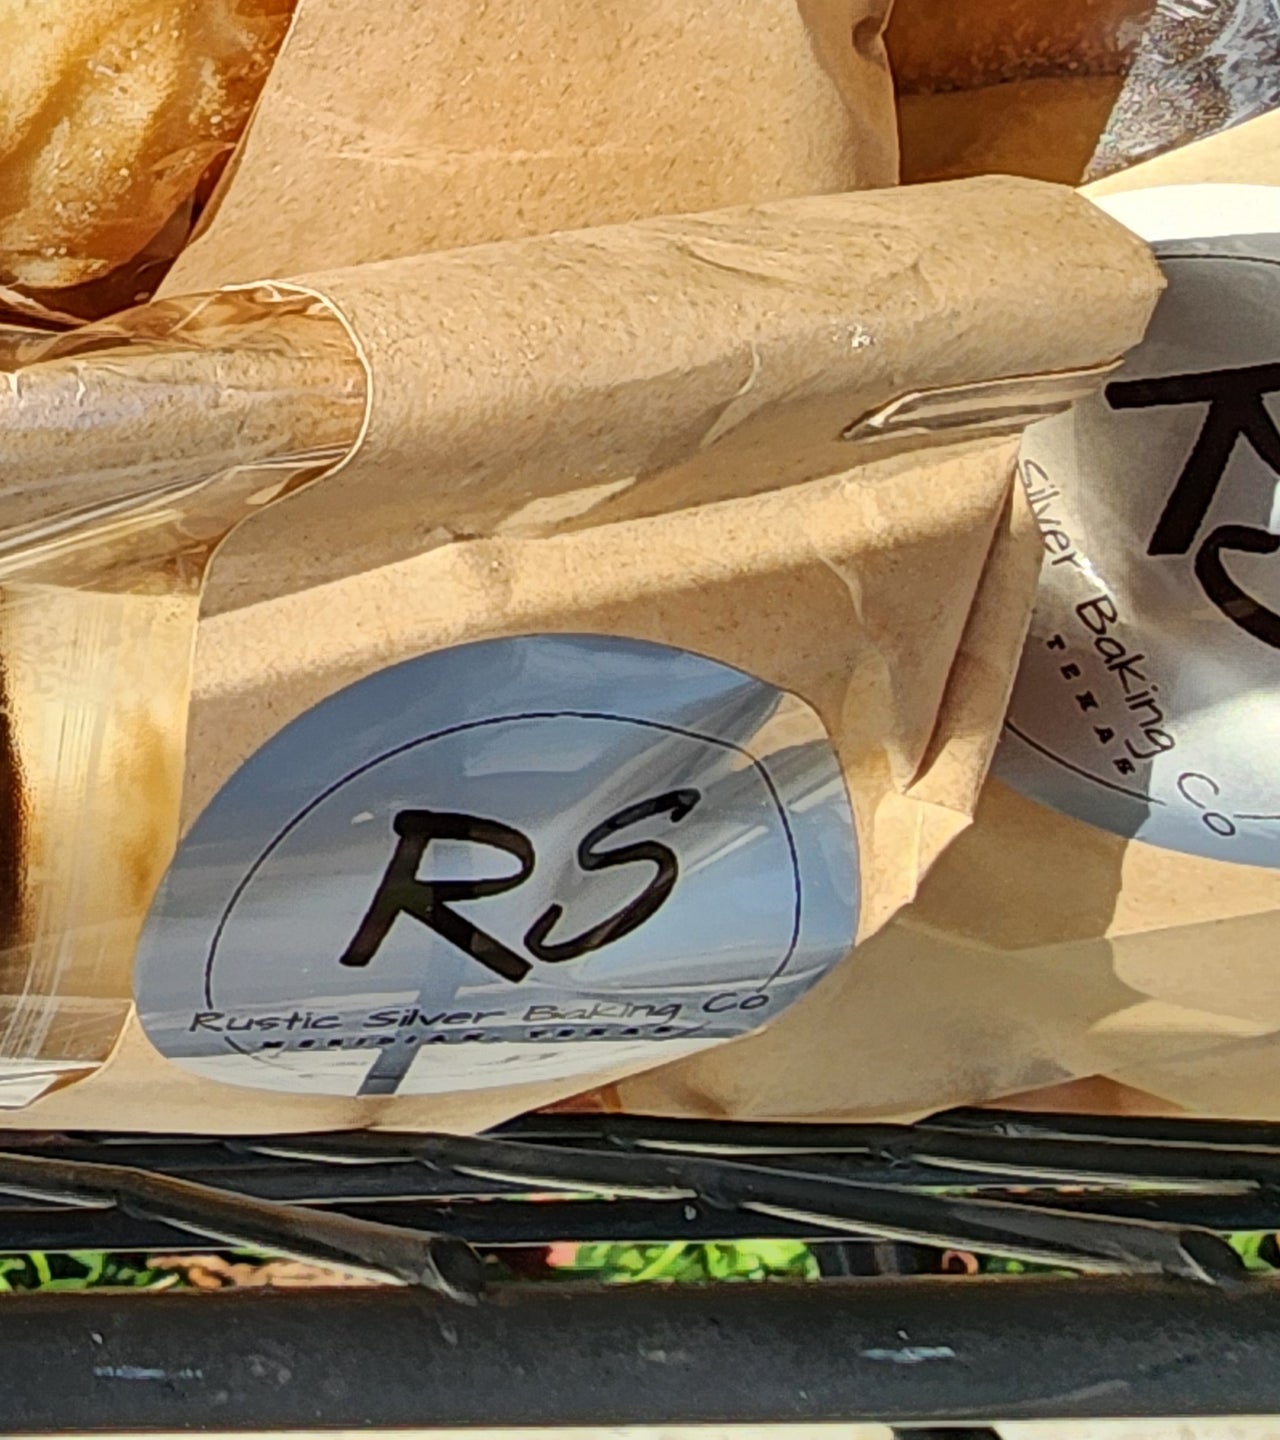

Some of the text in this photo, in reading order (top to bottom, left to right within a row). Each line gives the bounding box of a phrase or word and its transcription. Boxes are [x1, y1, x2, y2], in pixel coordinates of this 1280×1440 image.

[1075, 594, 1176, 760] Baking
[1177, 772, 1236, 837] Co
[339, 788, 701, 983] RS
[189, 1011, 343, 1033] Rustic
[362, 1008, 507, 1028] Silver
[702, 991, 770, 1012] Co
